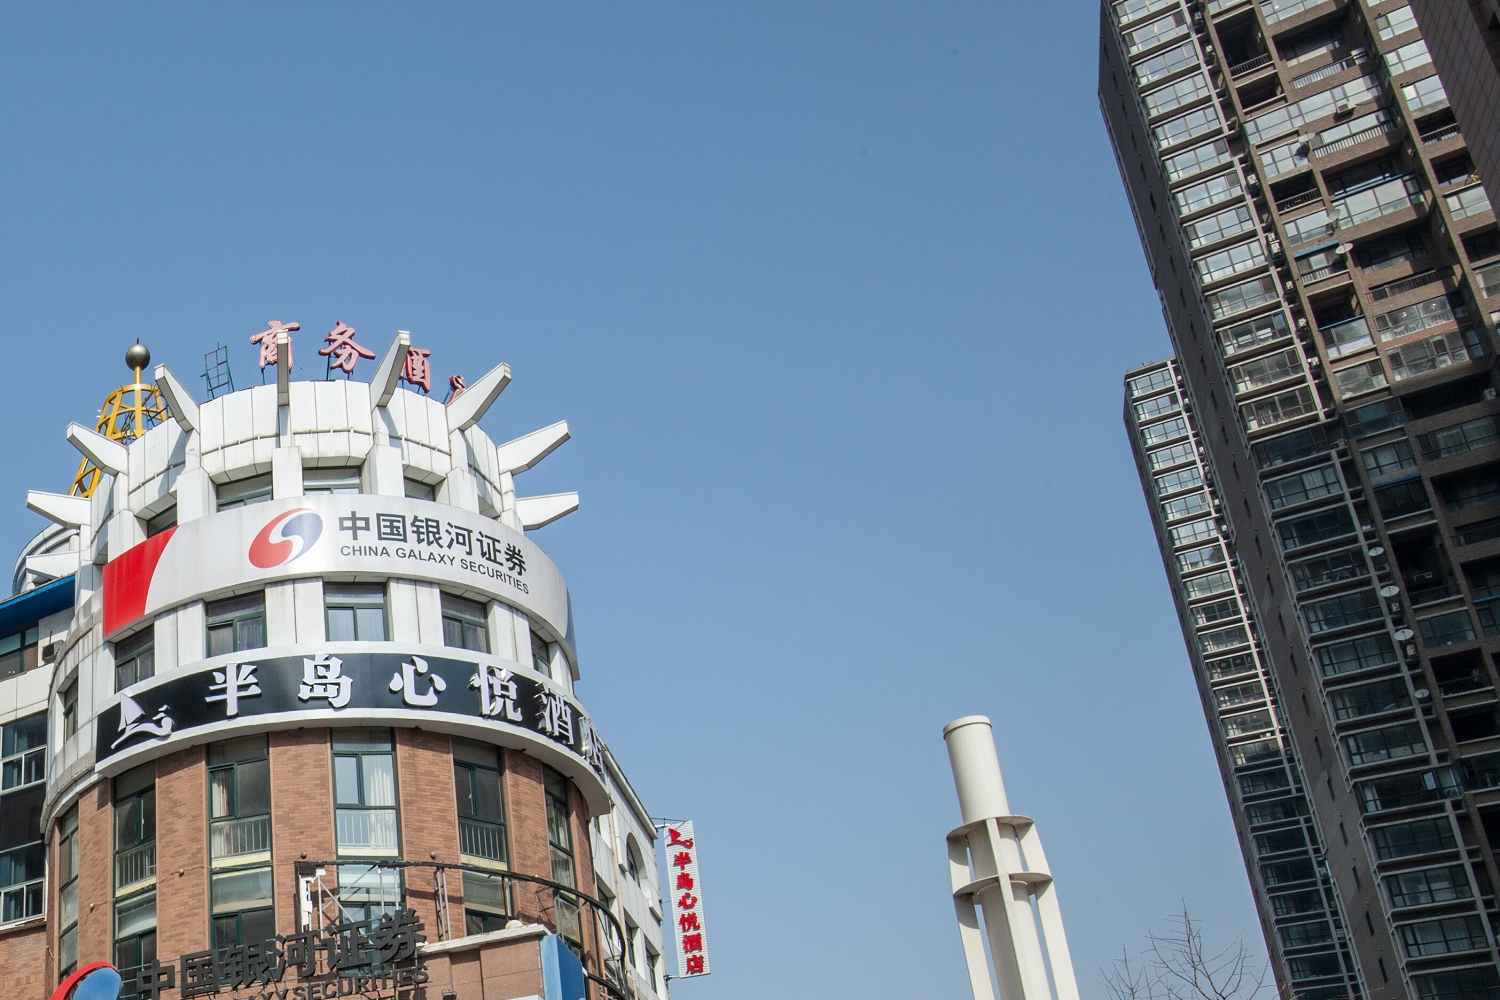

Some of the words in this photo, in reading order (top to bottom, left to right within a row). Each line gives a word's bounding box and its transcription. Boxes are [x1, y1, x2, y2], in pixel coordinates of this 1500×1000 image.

[338, 509, 528, 577] 中国银河证券
[340, 544, 391, 559] CHINA
[395, 546, 456, 567] GALAXY
[459, 557, 530, 595] SECURITIES
[672, 851, 705, 977] 半岛心悦酒店
